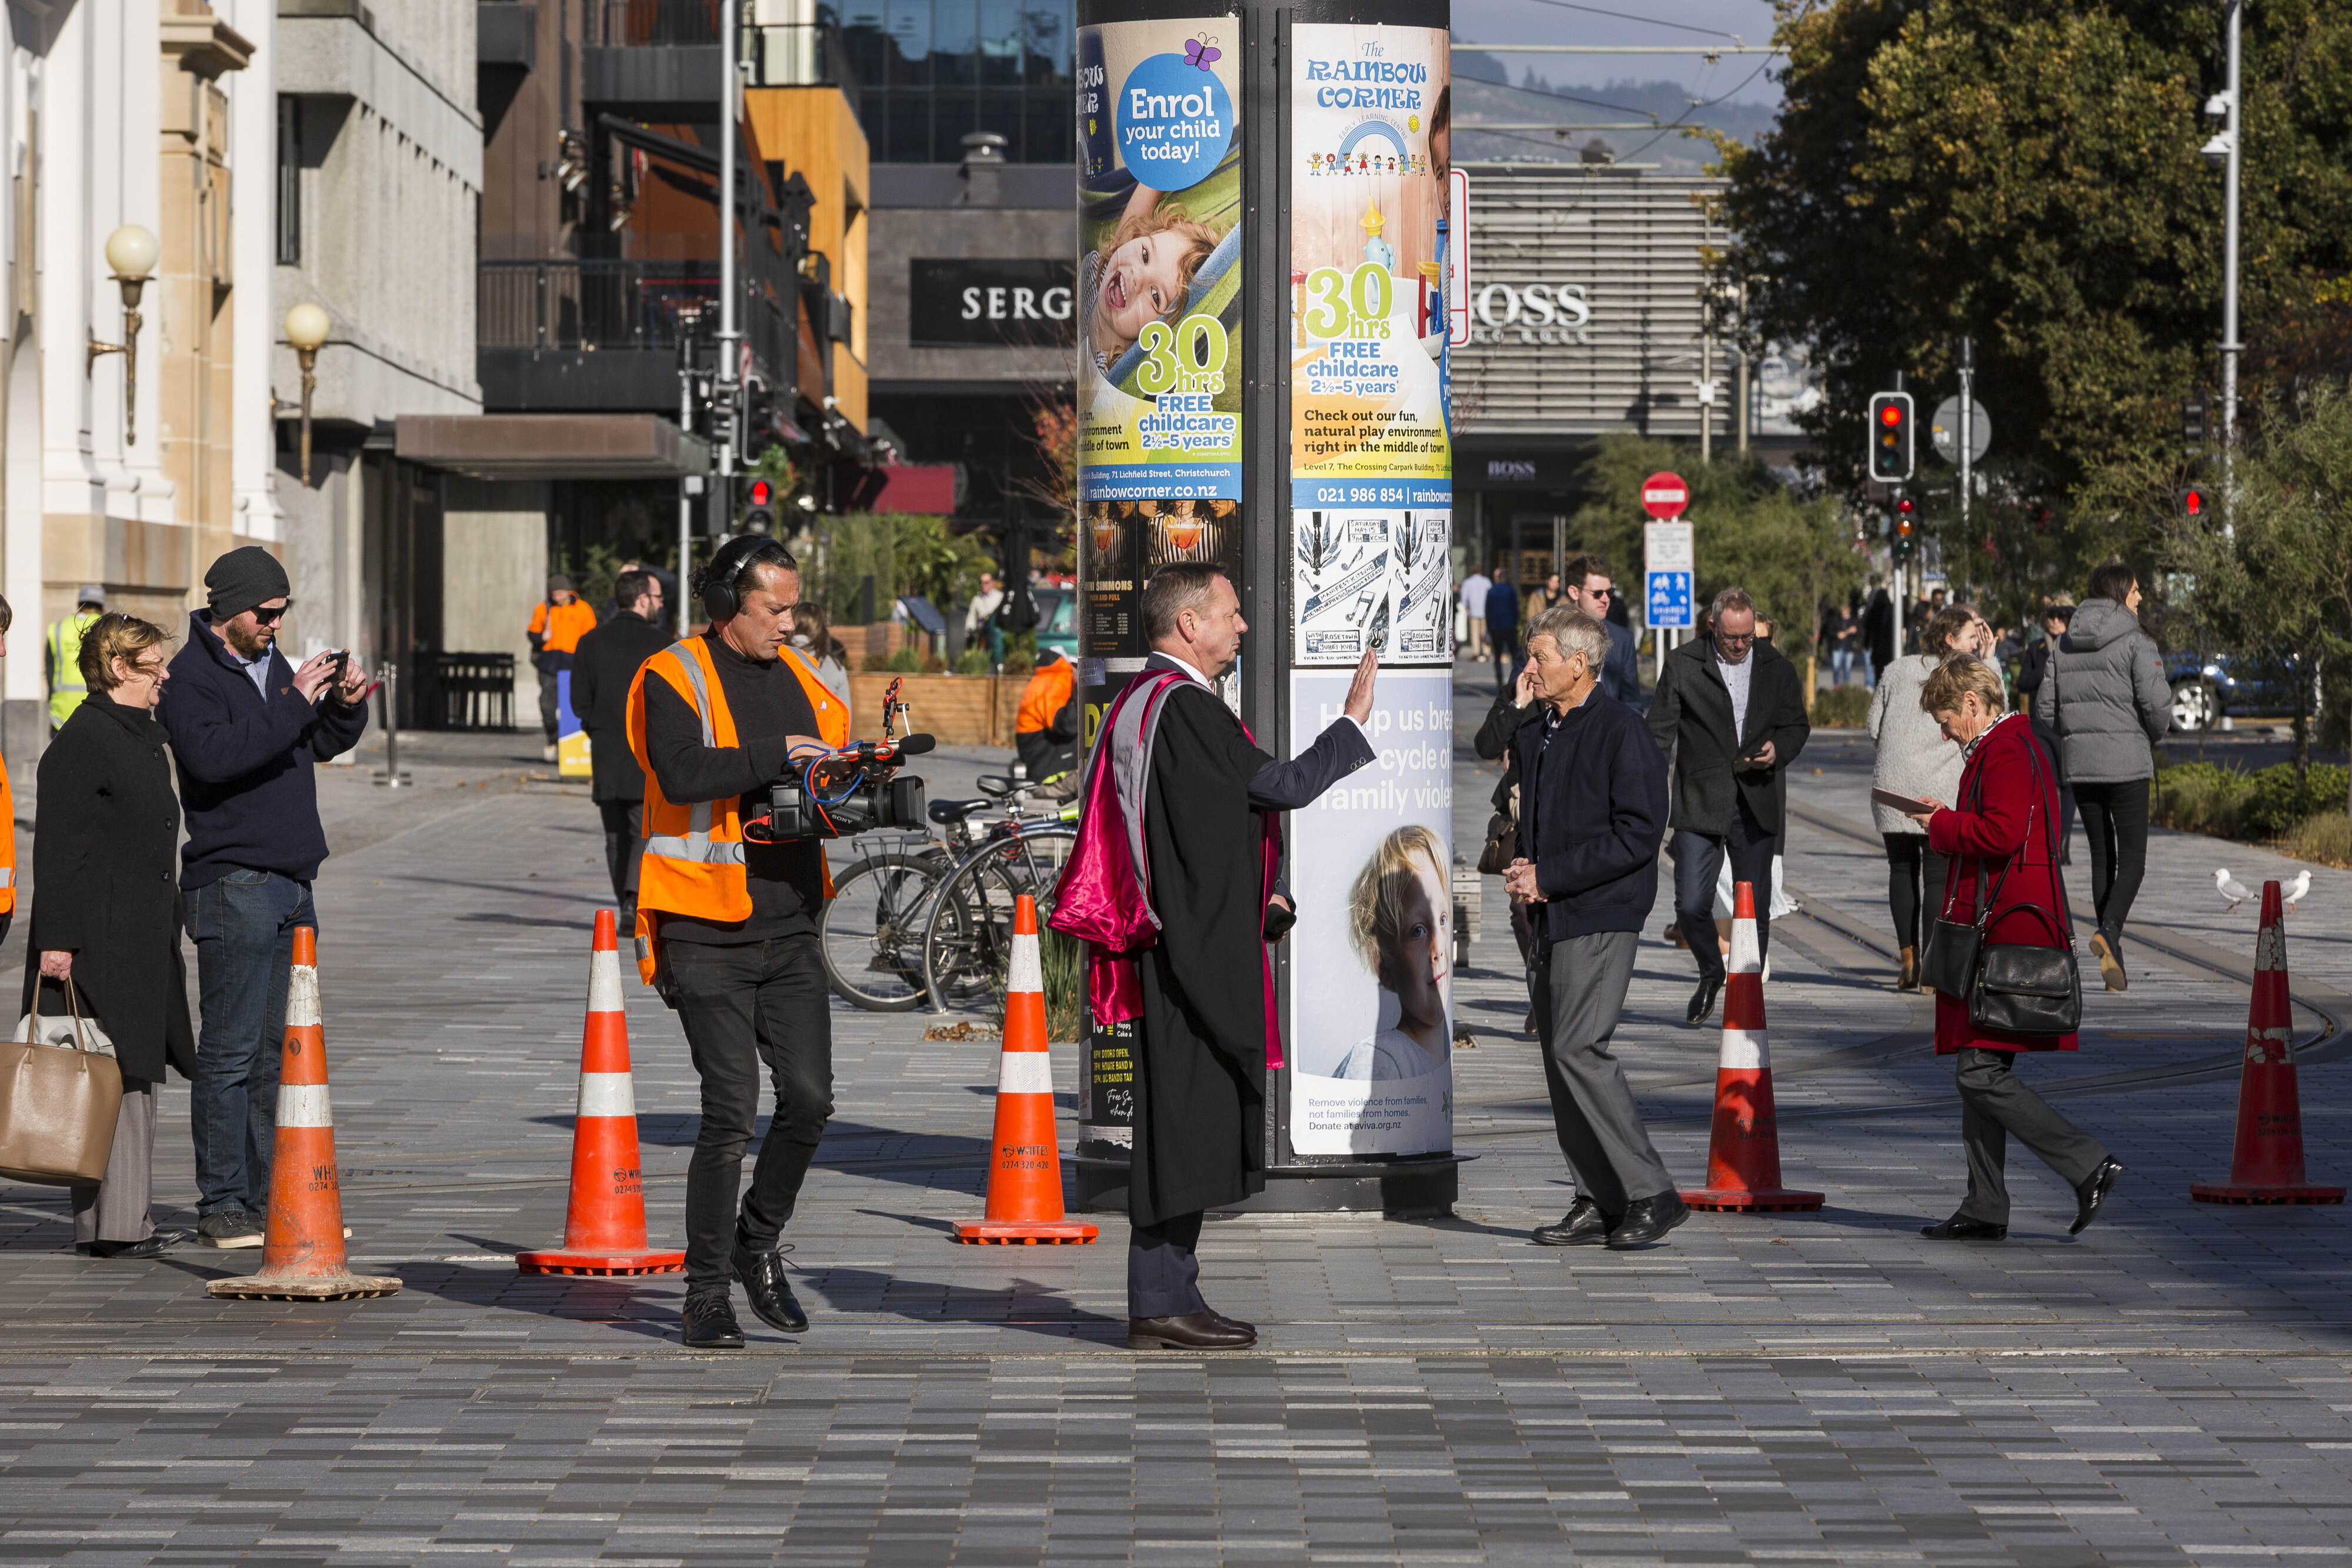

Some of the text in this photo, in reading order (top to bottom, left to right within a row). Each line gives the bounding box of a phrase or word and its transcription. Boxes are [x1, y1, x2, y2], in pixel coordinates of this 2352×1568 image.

[1362, 41, 1384, 57] The
[1306, 59, 1426, 84] RAINBOW
[1130, 86, 1214, 119] Enrol
[1317, 86, 1421, 110] CORNER
[1126, 119, 1220, 145] your child
[1339, 114, 1408, 141] EARLY LEARNING CENTRE
[1141, 141, 1199, 164] today!
[961, 286, 1072, 320] SERG
[1306, 263, 1393, 338] 30
[1472, 283, 1590, 328] OSS
[1349, 312, 1390, 339] hrs
[1137, 315, 1227, 395] 30
[1330, 342, 1380, 358] FREE
[1307, 359, 1399, 377] childcare
[1176, 366, 1225, 394] hrs
[1158, 395, 1211, 412] FREE
[1139, 413, 1235, 432] childcare
[1304, 410, 1418, 423] Check out our fun,
[1304, 425, 1442, 439] natural play environment
[1096, 439, 1104, 451] of
[1106, 440, 1129, 451] town
[1304, 441, 1444, 455] right in the middle of town
[1091, 471, 1110, 480] Building,
[1120, 470, 1147, 478] Lichfield
[1149, 469, 1173, 478] Street,
[1175, 469, 1230, 478] Christchurch
[1355, 463, 1387, 472] Crossing
[1389, 463, 1413, 472] Carpark
[1488, 461, 1536, 476] BOSS
[1090, 484, 1217, 499] rainbowcorner.co.nz
[1317, 488, 1346, 502] 021
[1350, 488, 1376, 502] 986
[1380, 488, 1403, 502] 854
[1096, 580, 1133, 591] SIMMONS
[1305, 590, 1347, 619] METAMORPHOSIS
[1652, 606, 1687, 616] SHARED
[1659, 615, 1680, 625] ZONE
[1320, 700, 1453, 738] Hp us brea
[1379, 739, 1450, 776] cycle of
[1320, 779, 1453, 816] family violen
[832, 814, 853, 823] SONY
[1102, 1049, 1116, 1058] DOORS
[1116, 1048, 1129, 1057] OPEN.
[1102, 1061, 1115, 1070] HOUSE
[1116, 1060, 1128, 1070] BAND
[1102, 1073, 1108, 1083] UC
[1109, 1073, 1123, 1083] BANDS
[1106, 1089, 1122, 1104] Free
[1309, 1095, 1428, 1107] Remove violence from families,
[1326, 1109, 1360, 1118] families
[1362, 1109, 1382, 1117] from
[1384, 1108, 1410, 1117] homes.
[1309, 1122, 1342, 1130] Donate
[1355, 1121, 1402, 1130] aviva.org.nz
[1016, 1146, 1049, 1156] WHITES
[1002, 1160, 1049, 1169] 0274 320 420
[309, 1182, 328, 1192] 0274
[615, 1185, 632, 1194] 0274
